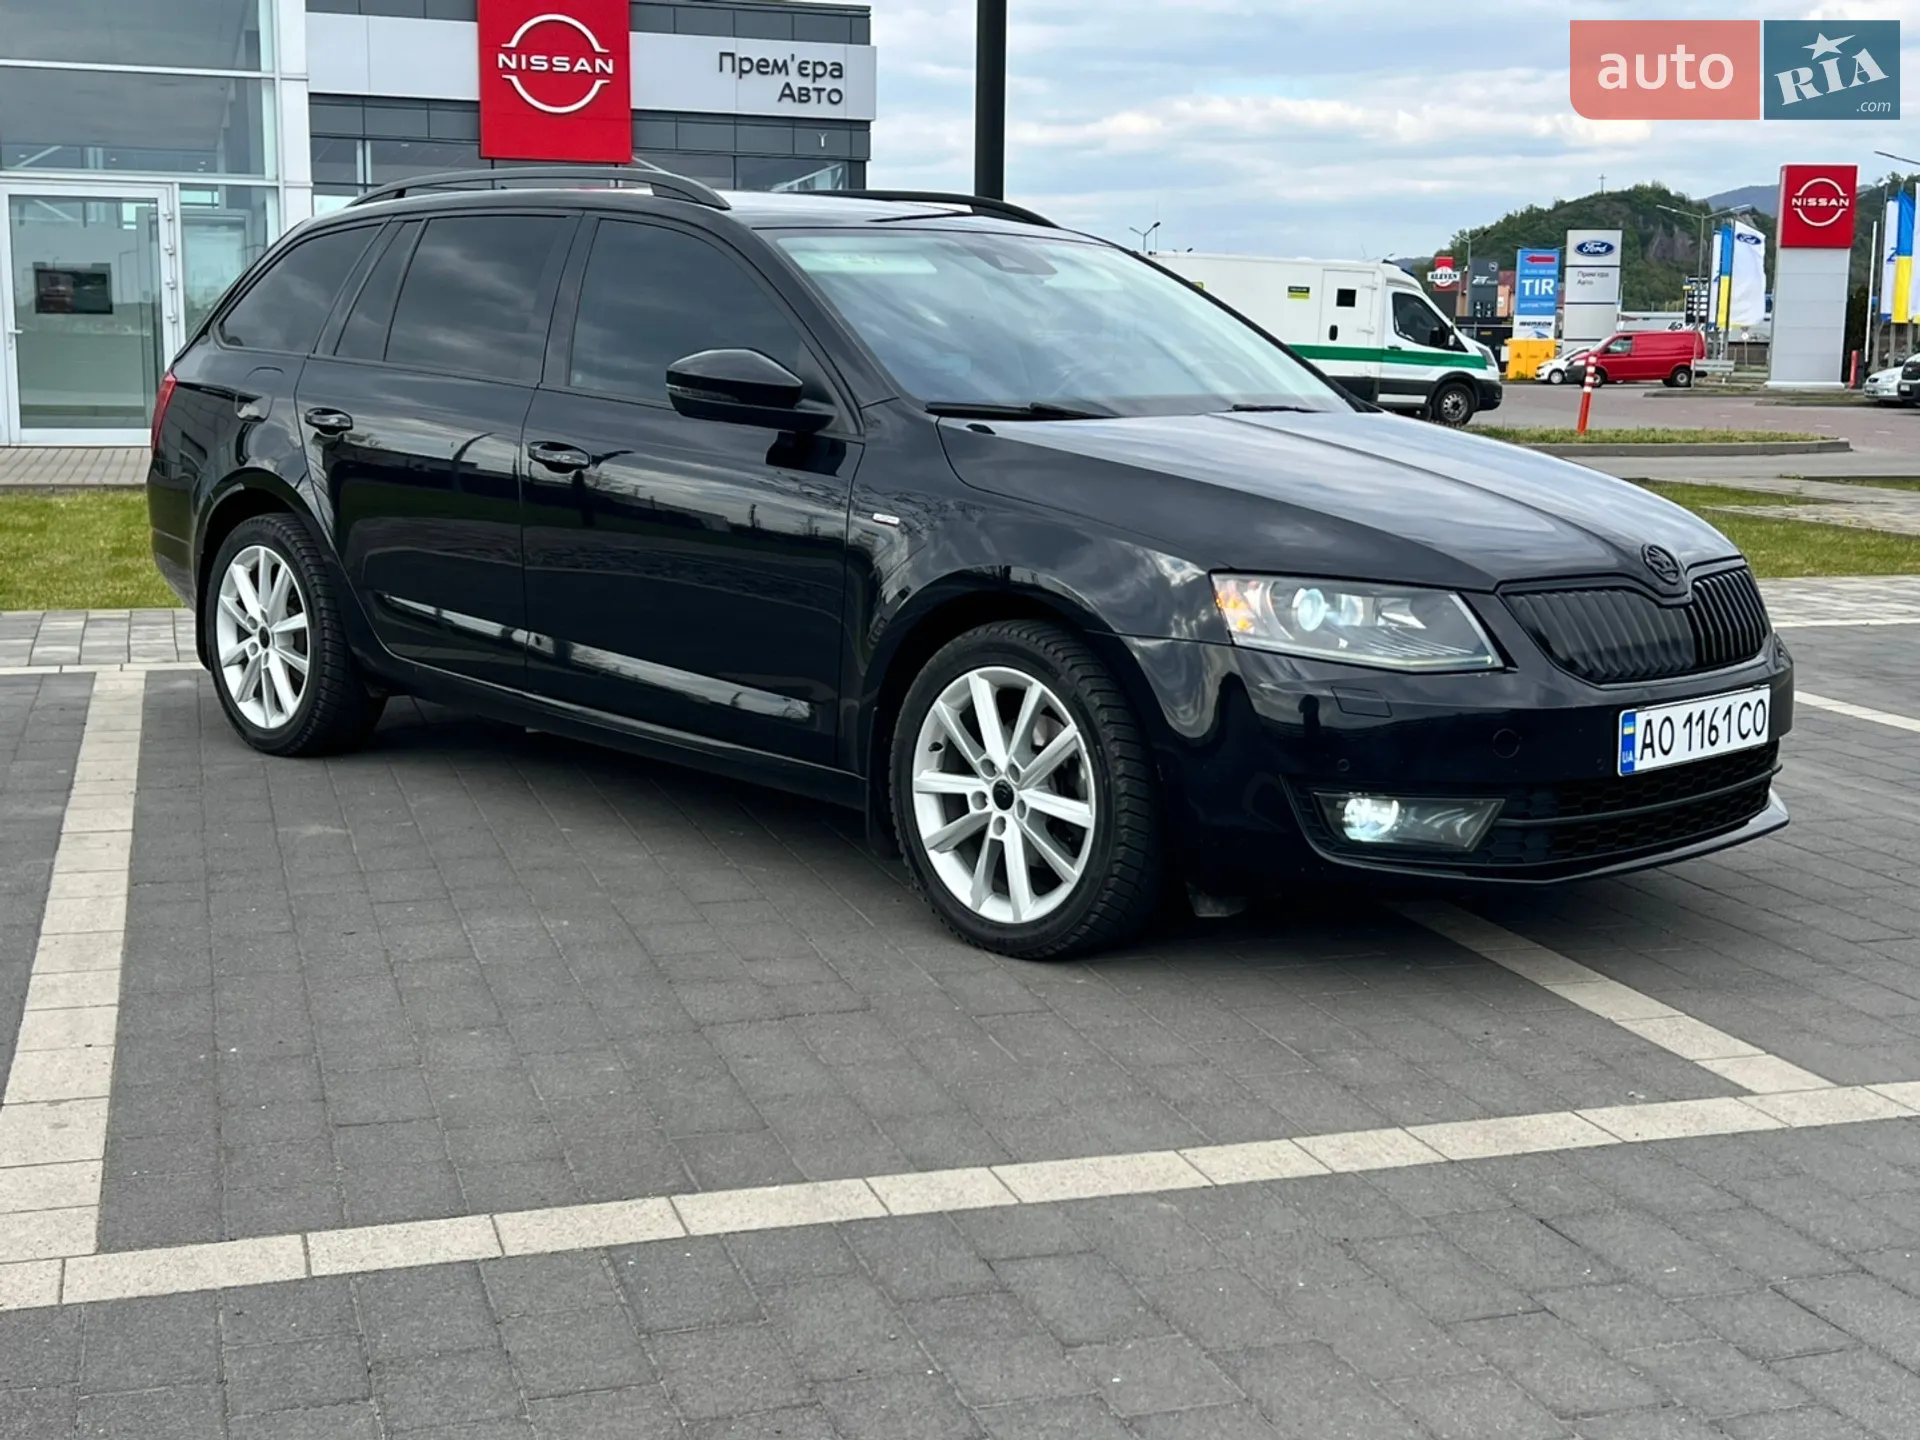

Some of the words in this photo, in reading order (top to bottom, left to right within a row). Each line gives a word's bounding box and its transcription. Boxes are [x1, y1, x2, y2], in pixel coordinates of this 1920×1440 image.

[497, 53, 614, 75] NISSAN
[718, 51, 844, 82] Прем'єра
[778, 82, 843, 105] Авто
[1792, 197, 1849, 207] NISSAN
[1582, 241, 1608, 253] Ford
[1430, 272, 1458, 280] ELEVEN
[1521, 278, 1555, 296] TIR
[1640, 716, 1675, 761] AO
[1622, 751, 1634, 763] UA
